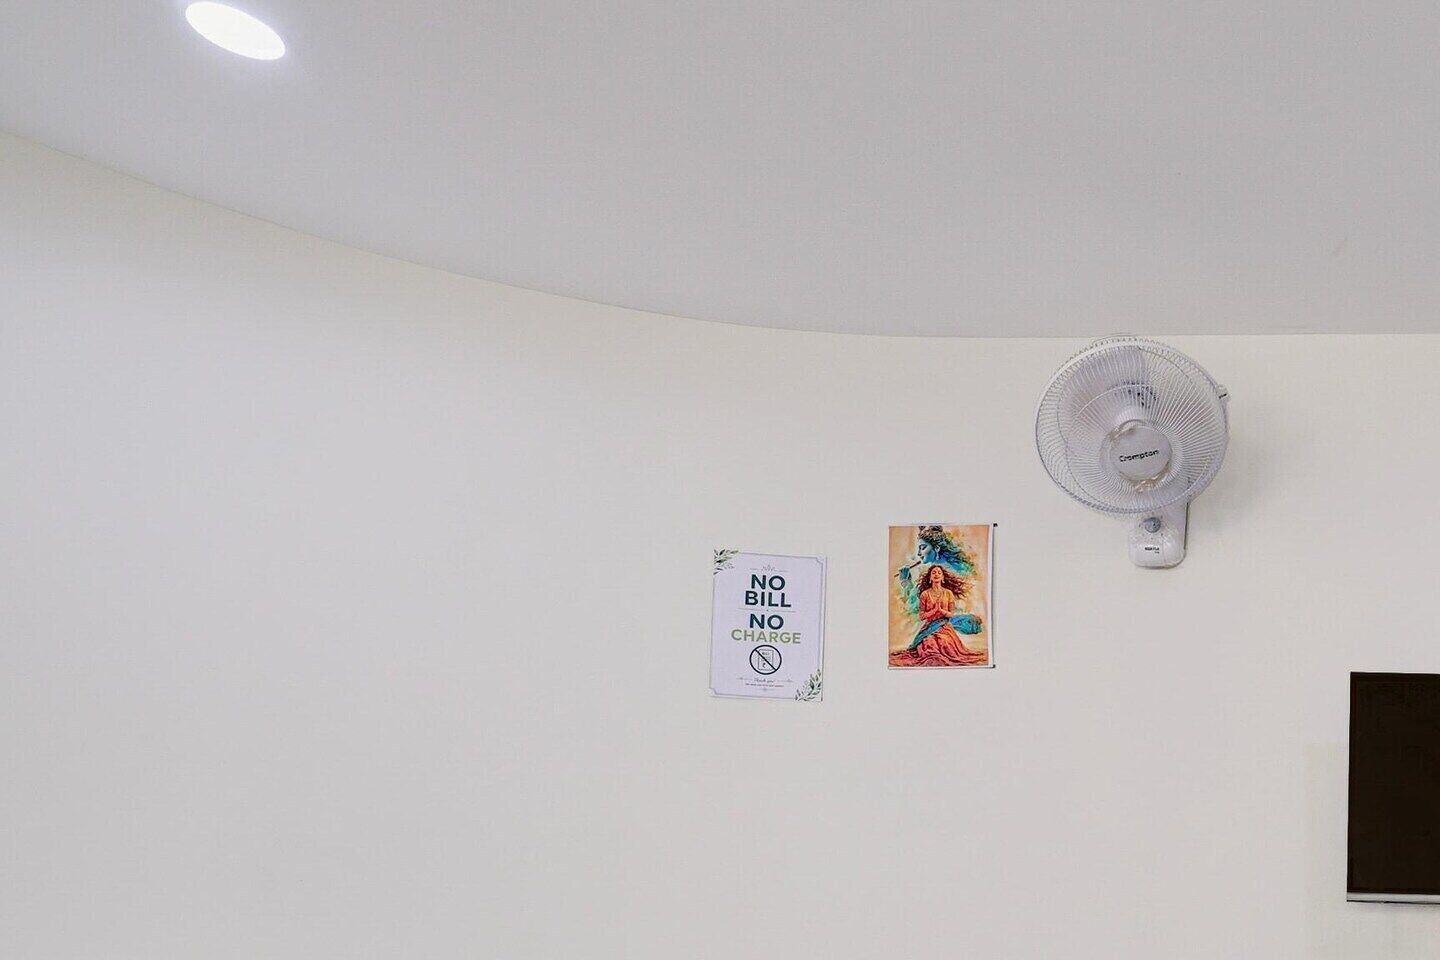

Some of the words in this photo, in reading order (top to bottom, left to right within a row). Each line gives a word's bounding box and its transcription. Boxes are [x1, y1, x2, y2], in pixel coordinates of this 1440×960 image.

[1119, 450, 1159, 462] Crompton
[751, 574, 786, 591] NO
[744, 591, 791, 608] BILL
[749, 613, 785, 630] NO
[731, 629, 801, 644] CHARGE
